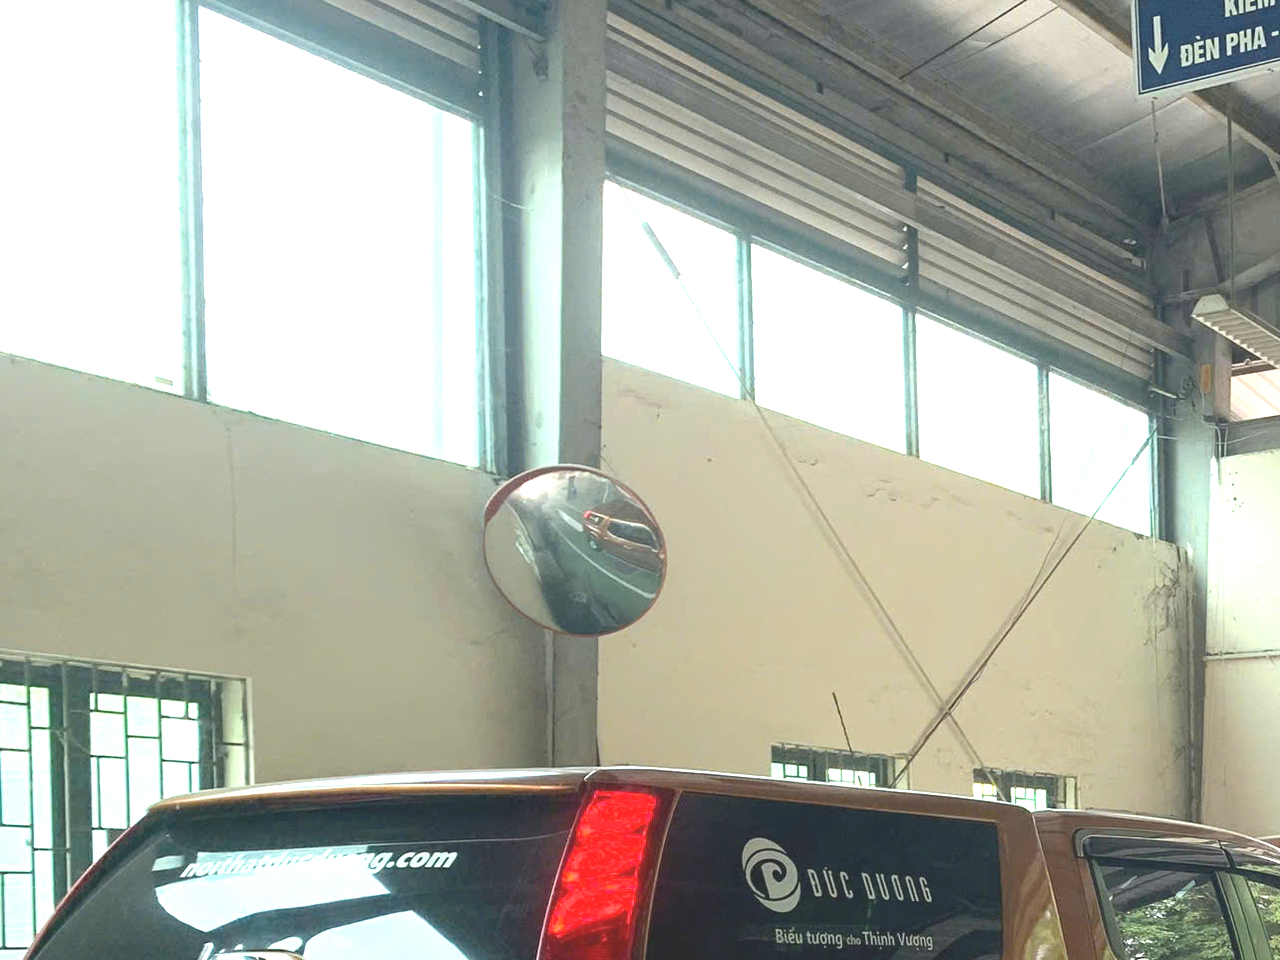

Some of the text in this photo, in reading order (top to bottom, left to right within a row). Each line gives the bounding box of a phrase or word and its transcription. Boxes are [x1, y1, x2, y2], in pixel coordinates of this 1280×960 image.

[1180, 35, 1220, 67] ĐÈN
[1225, 26, 1267, 57] PHA
[806, 930, 843, 950] tượng
[846, 935, 862, 946] cho
[862, 931, 895, 950] Thịnh
[897, 932, 933, 951] Vượng
